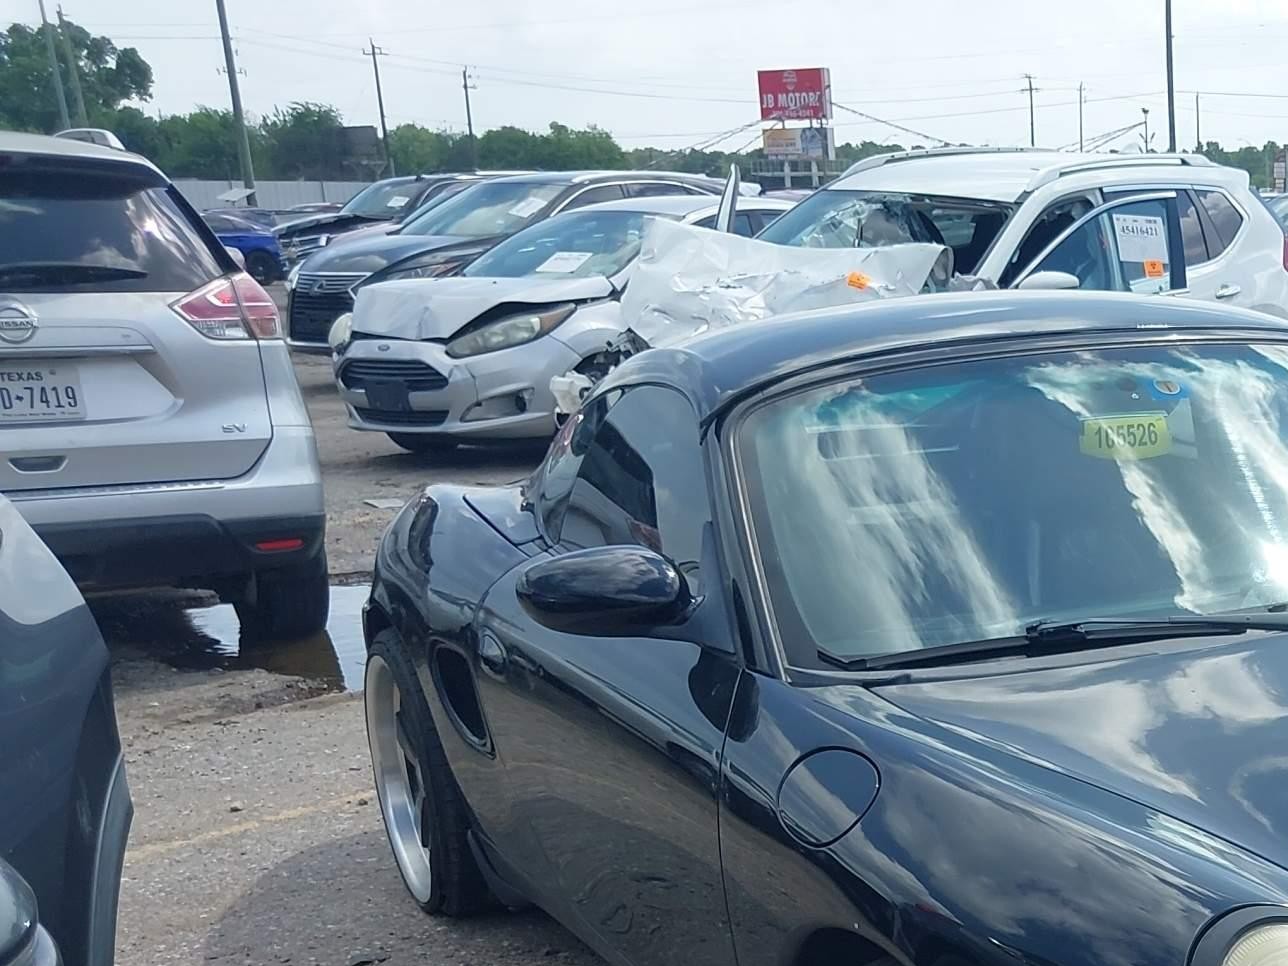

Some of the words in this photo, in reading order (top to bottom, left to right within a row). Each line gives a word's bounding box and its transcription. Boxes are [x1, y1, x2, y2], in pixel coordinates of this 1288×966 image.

[762, 93, 774, 109] JB
[0, 320, 34, 329] ISSAN
[0, 371, 43, 382] TEXAS
